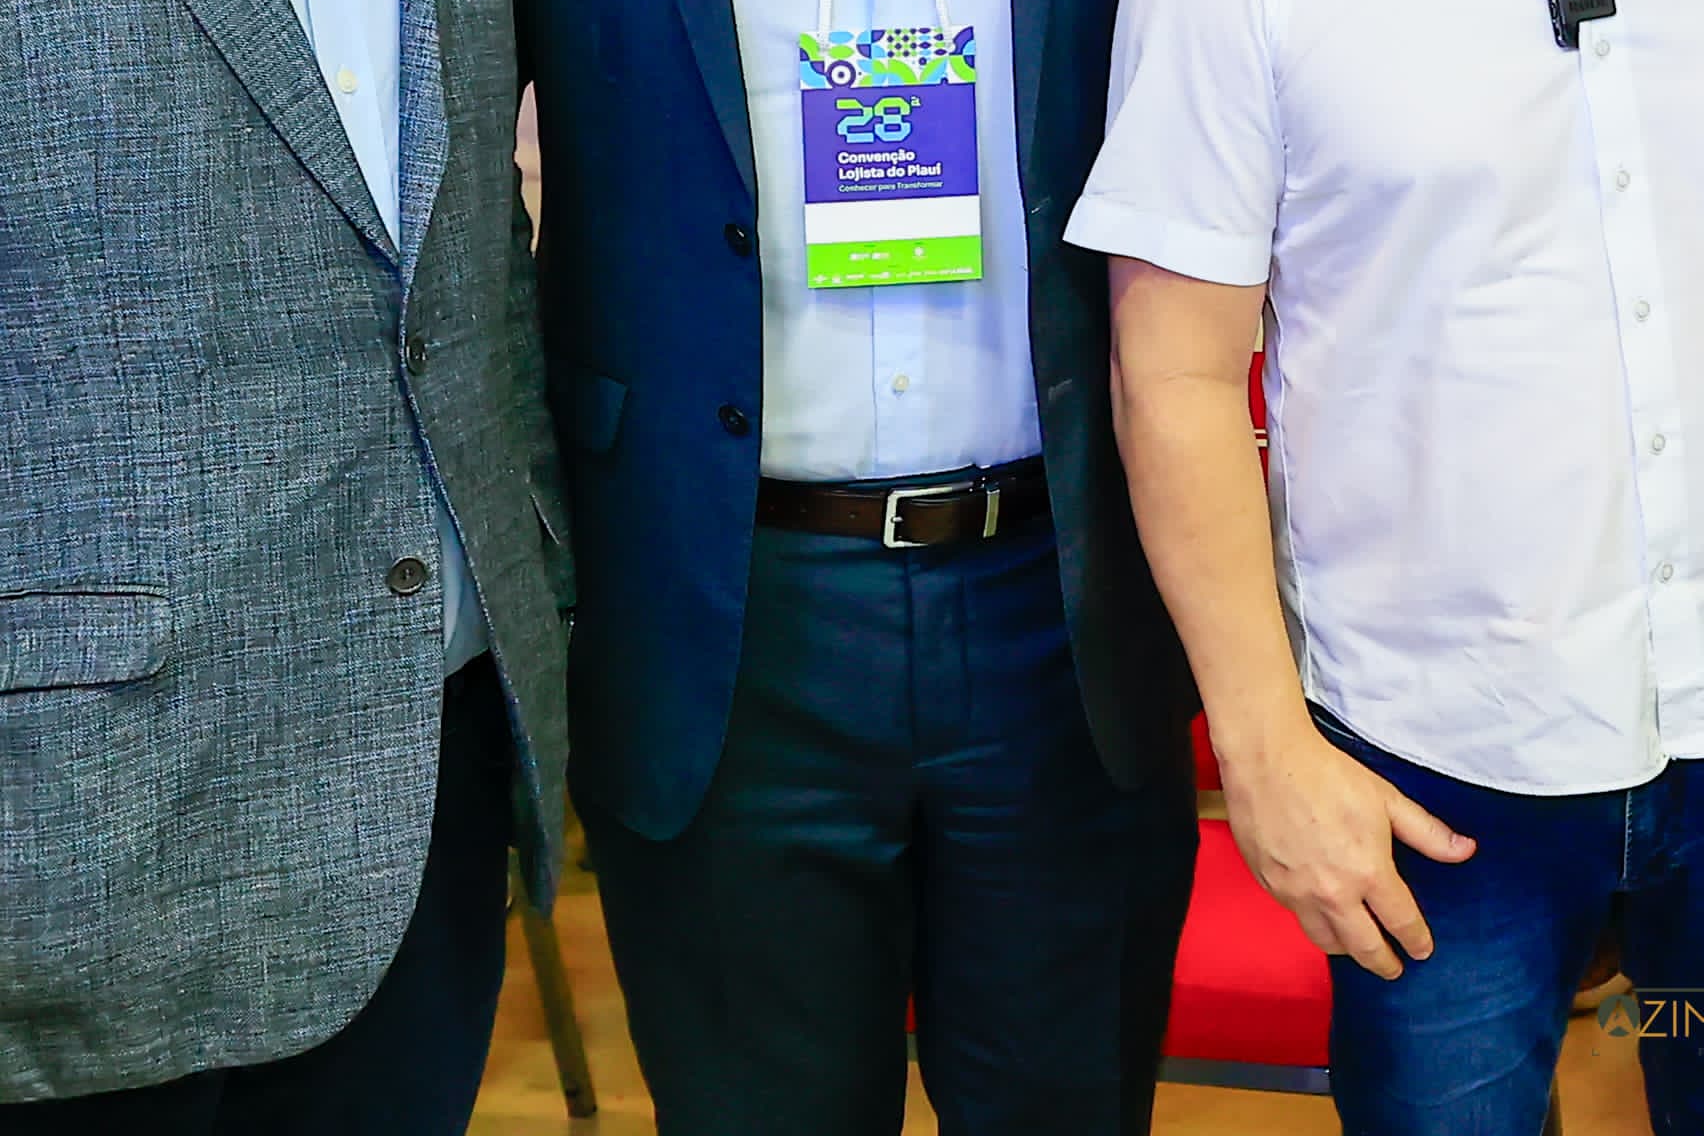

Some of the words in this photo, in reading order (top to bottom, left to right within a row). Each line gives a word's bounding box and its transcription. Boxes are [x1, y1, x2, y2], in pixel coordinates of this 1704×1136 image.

[838, 149, 915, 165] Convenção
[839, 167, 884, 181] Lojista
[886, 166, 905, 178] do
[907, 163, 941, 176] Piauí
[897, 181, 943, 190] Transformar
